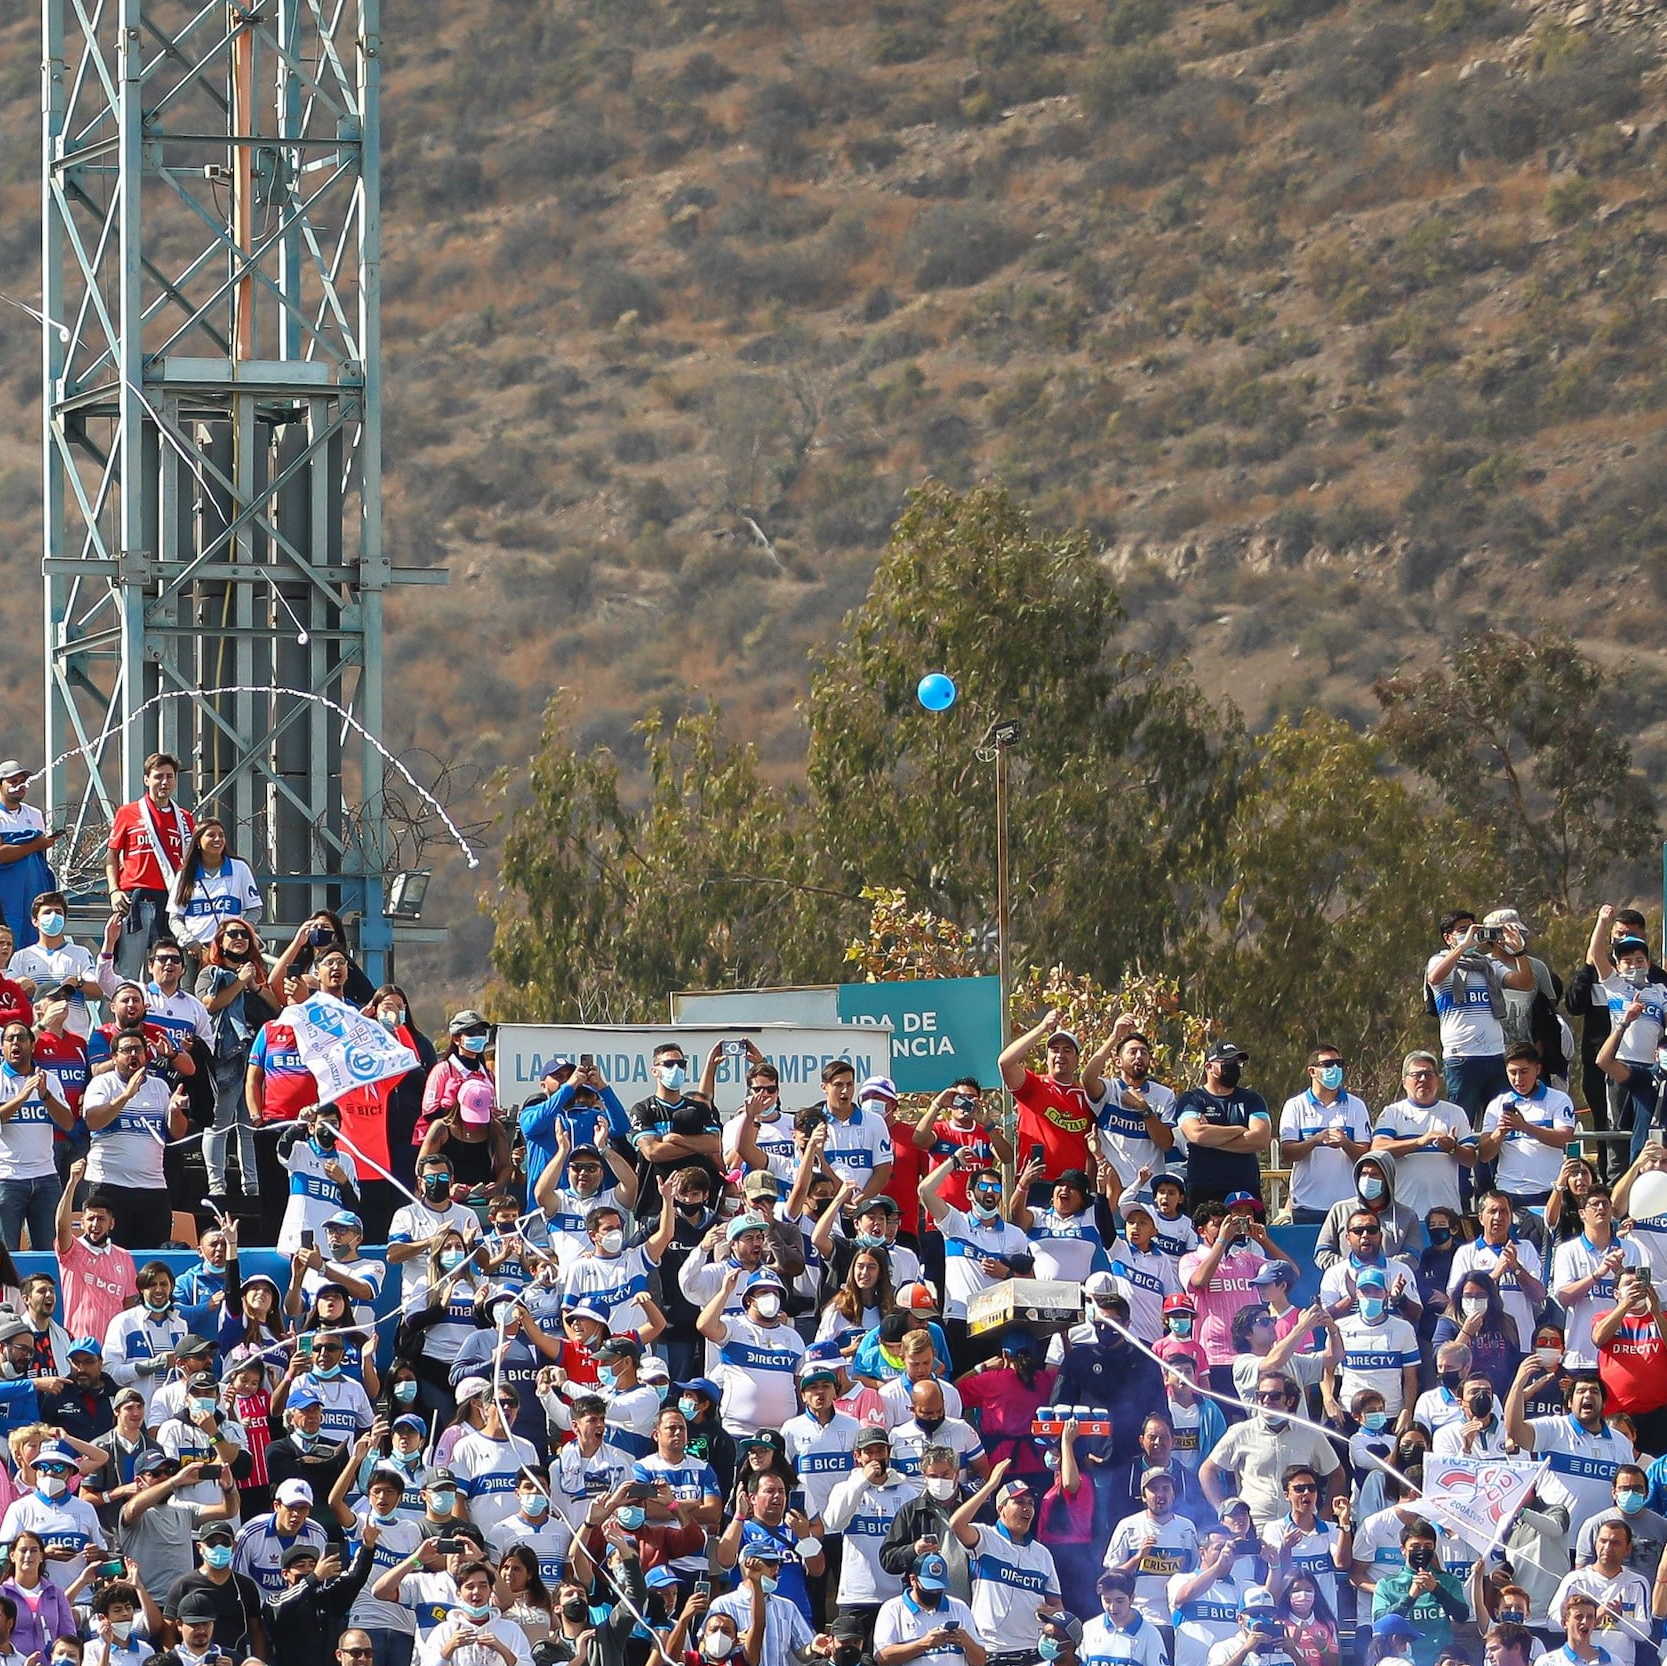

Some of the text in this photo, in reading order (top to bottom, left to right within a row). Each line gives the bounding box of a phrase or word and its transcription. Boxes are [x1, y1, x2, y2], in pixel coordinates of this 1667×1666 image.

[1469, 991, 1488, 1003] BIC
[903, 1011, 938, 1033] DE
[516, 1053, 543, 1083] LA
[21, 1108, 45, 1118] BIC
[322, 1184, 340, 1199] BIC
[1135, 1272, 1159, 1289] BICE
[542, 1317, 560, 1328] BIC
[747, 1352, 794, 1367] DIRECTV
[1345, 1354, 1394, 1369] DIRECTV
[508, 1368, 536, 1381] BICE
[1536, 1402, 1561, 1414] BIC
[814, 1457, 845, 1469] BICE
[1583, 1461, 1616, 1475] BICE
[485, 1477, 515, 1488] DIREC
[869, 1521, 891, 1533] BIC
